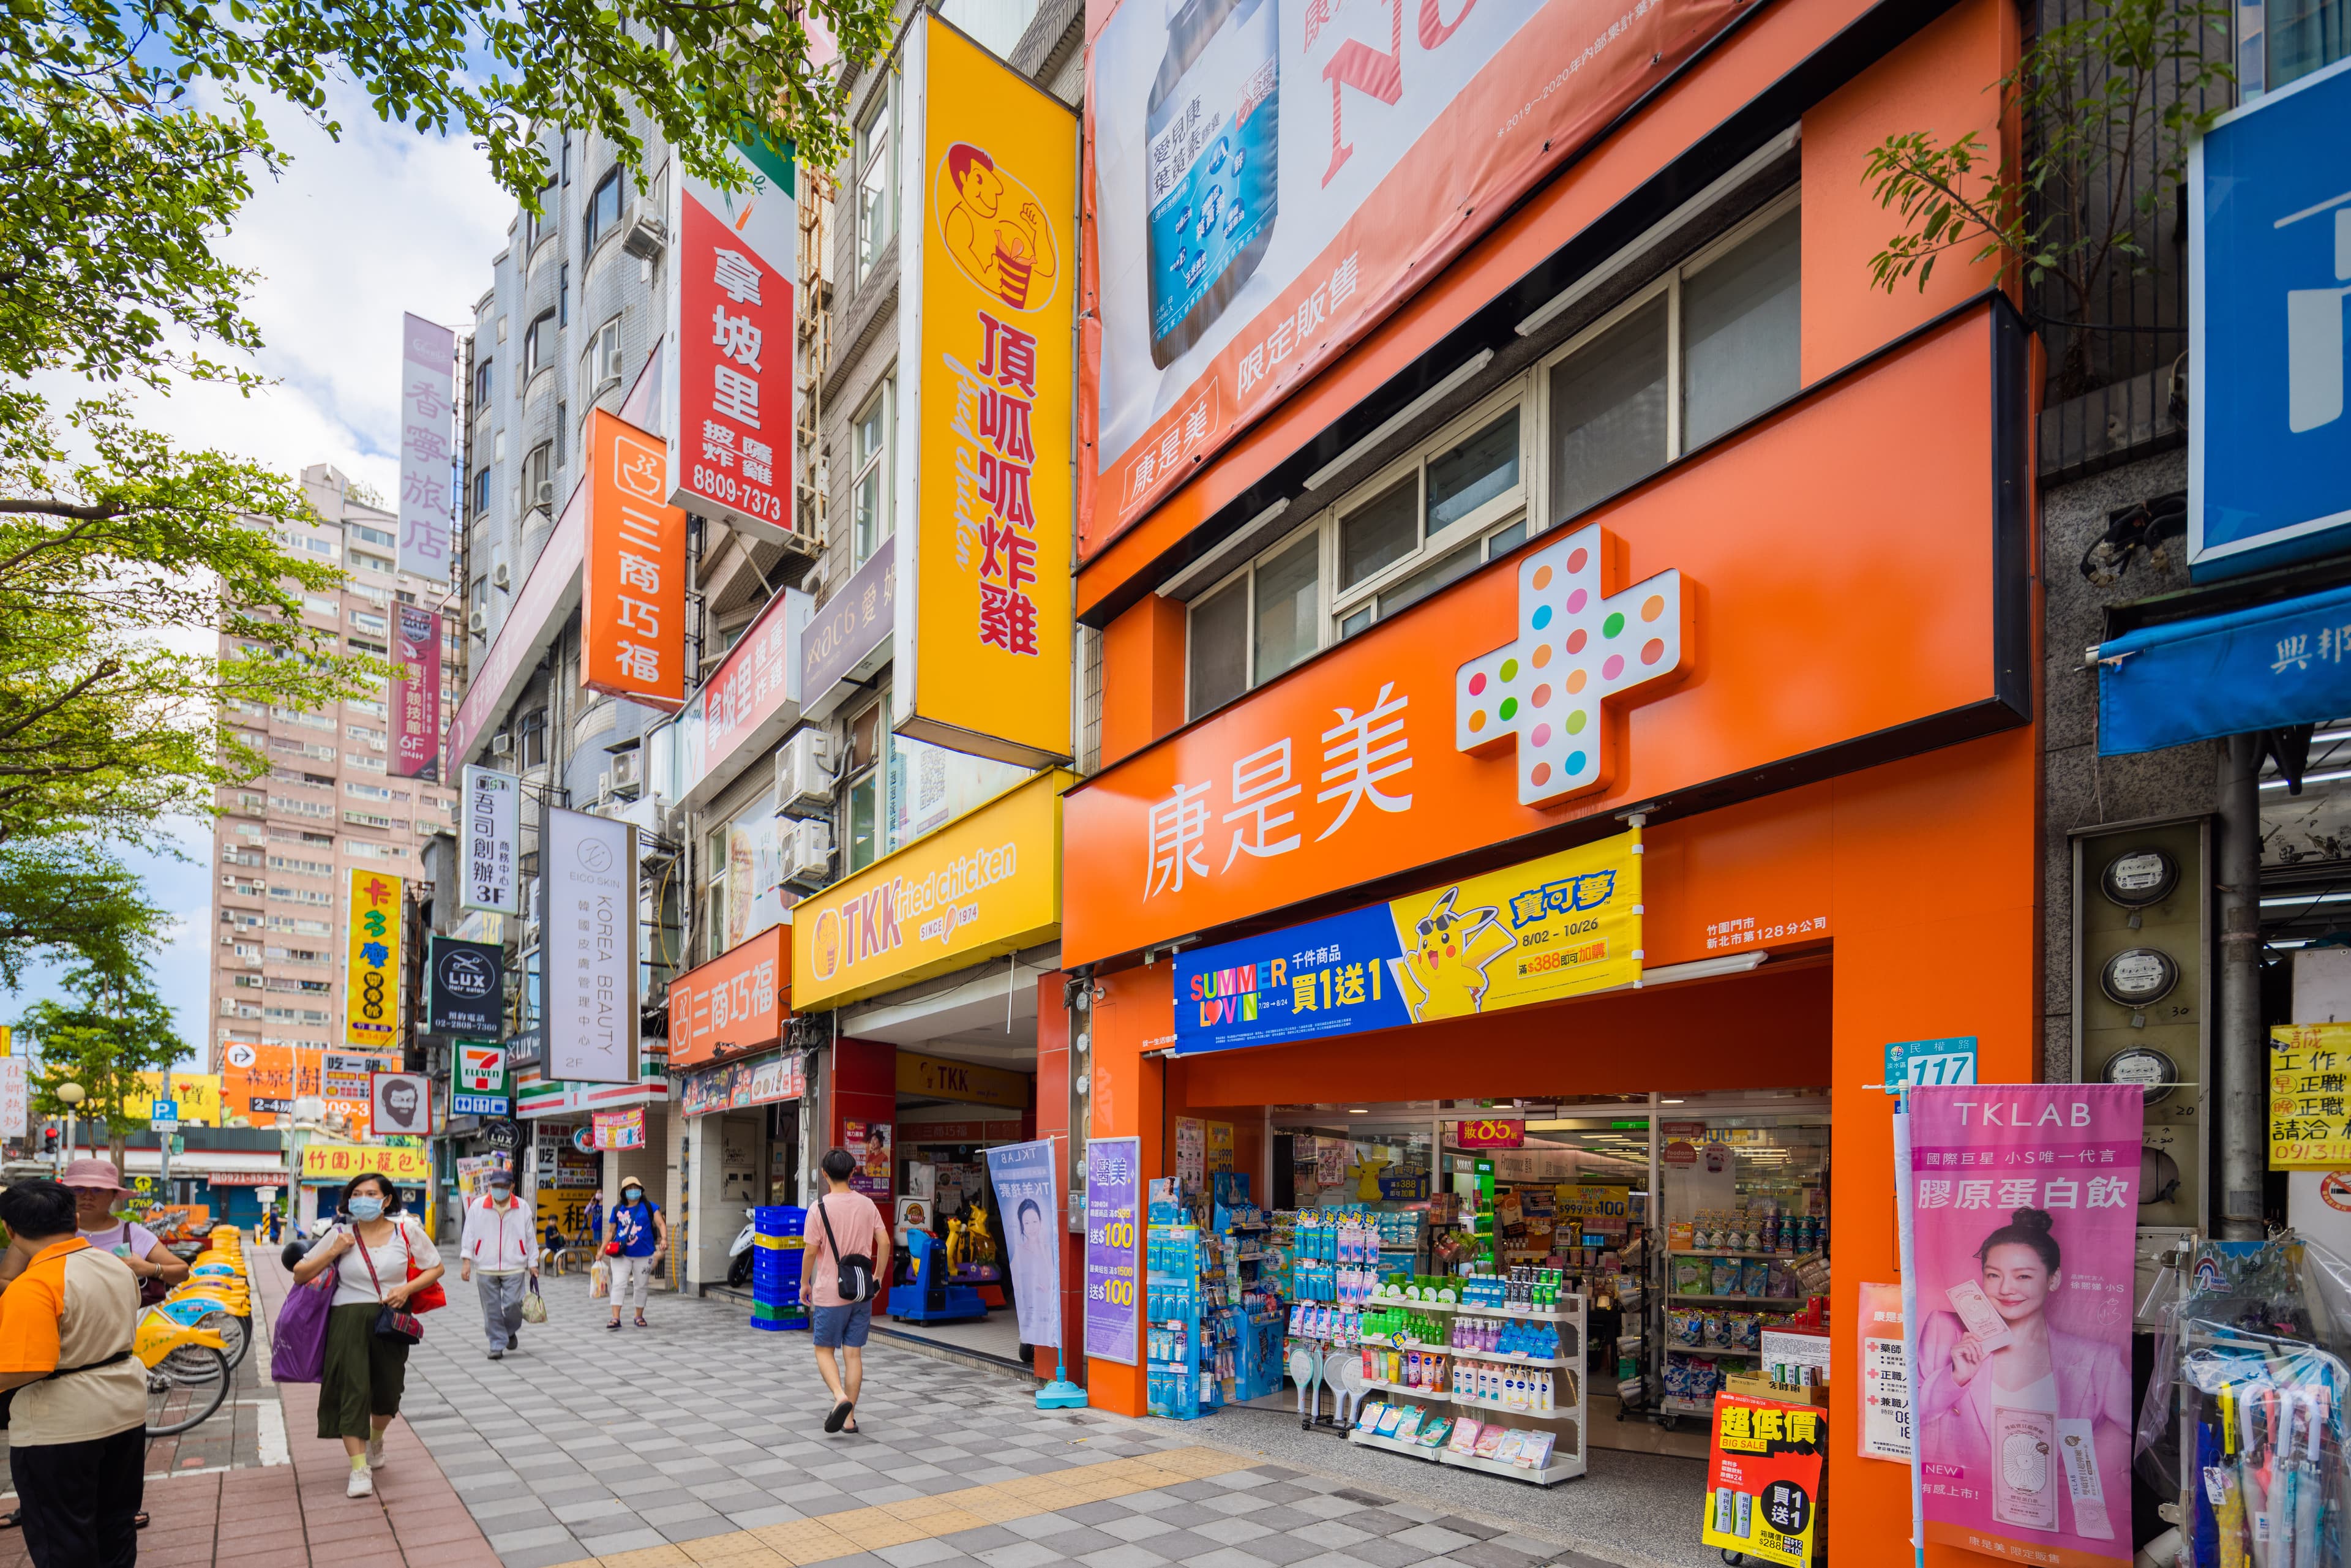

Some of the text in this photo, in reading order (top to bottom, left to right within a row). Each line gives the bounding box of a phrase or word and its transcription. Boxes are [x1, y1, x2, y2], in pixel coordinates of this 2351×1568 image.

[1154, 94, 1201, 171] 愛見康
[713, 246, 763, 430] 拿坡里
[1237, 252, 1359, 401] 限定販售
[1133, 400, 1209, 497] 康是美
[693, 464, 781, 521] 8809-7373
[978, 309, 1039, 657] 頂呱呱炸雞
[615, 505, 660, 684] 三商巧福
[405, 661, 422, 736] 電子競技館
[708, 652, 752, 752] 拿坡里
[399, 735, 425, 750] 6F
[1142, 681, 1414, 905] 康是美
[499, 840, 510, 887] 商務中心
[569, 871, 620, 889] EICO SKIN
[477, 885, 505, 904] 3F
[842, 876, 903, 967] TKK
[936, 842, 1017, 905] chicken
[1512, 871, 1615, 928] 寶可夢
[360, 878, 391, 969] 卡多摩
[920, 904, 979, 940] SINCE 1974
[1522, 918, 1599, 947] 8/02 10/26
[1706, 917, 1755, 936] 竹圍門市
[1706, 916, 1826, 950] 新北市第128分公司
[1292, 943, 1341, 970] 千件商品
[449, 972, 485, 988] LUX
[577, 899, 591, 1046] 韓國皮膚管理中心
[597, 895, 613, 1056] KOREA BEAUTY
[1190, 957, 1288, 1001] SUMMER
[1291, 958, 1381, 1015] 買1送1
[692, 958, 774, 1038] 三商巧福
[435, 1018, 497, 1032] 02-2808-7360
[2290, 1029, 2322, 1049] 誠
[516, 1035, 532, 1060] LUX
[1910, 1039, 1970, 1054] 民權路
[566, 1057, 583, 1068] 2F
[1913, 1056, 1970, 1086] 117
[2274, 1051, 2351, 1071] 工作
[937, 1065, 969, 1093] TKK
[2296, 1073, 2347, 1093] 正職
[155, 1103, 170, 1119] P
[1953, 1103, 2091, 1127] TKLAB
[2296, 1097, 2345, 1116] 正職
[490, 1133, 512, 1144] LUX
[308, 1150, 415, 1173] 竹圍小籠包
[1501, 1153, 1524, 1177] Fragrance
[1926, 1149, 2117, 1166] 國際巨星 小S唯一代言
[1097, 1158, 1127, 1187] 醫美
[1918, 1176, 2130, 1210] 膠原蛋白飲
[1090, 1221, 1133, 1249] 送$100
[1089, 1278, 1133, 1306] 送$100
[2070, 1280, 2124, 1292] 徐熙娣 小S
[1881, 1343, 1902, 1354] 藥師
[1720, 1406, 1817, 1445] 超低價
[1722, 1439, 1765, 1450] BIG SALE
[1925, 1464, 1959, 1476] NEW
[2070, 1474, 2079, 1495] TKLAB
[1759, 1538, 1781, 1551] $288
[1760, 1530, 1782, 1542] 箱購價
[1968, 1536, 2060, 1565] 康是美 限定販售
